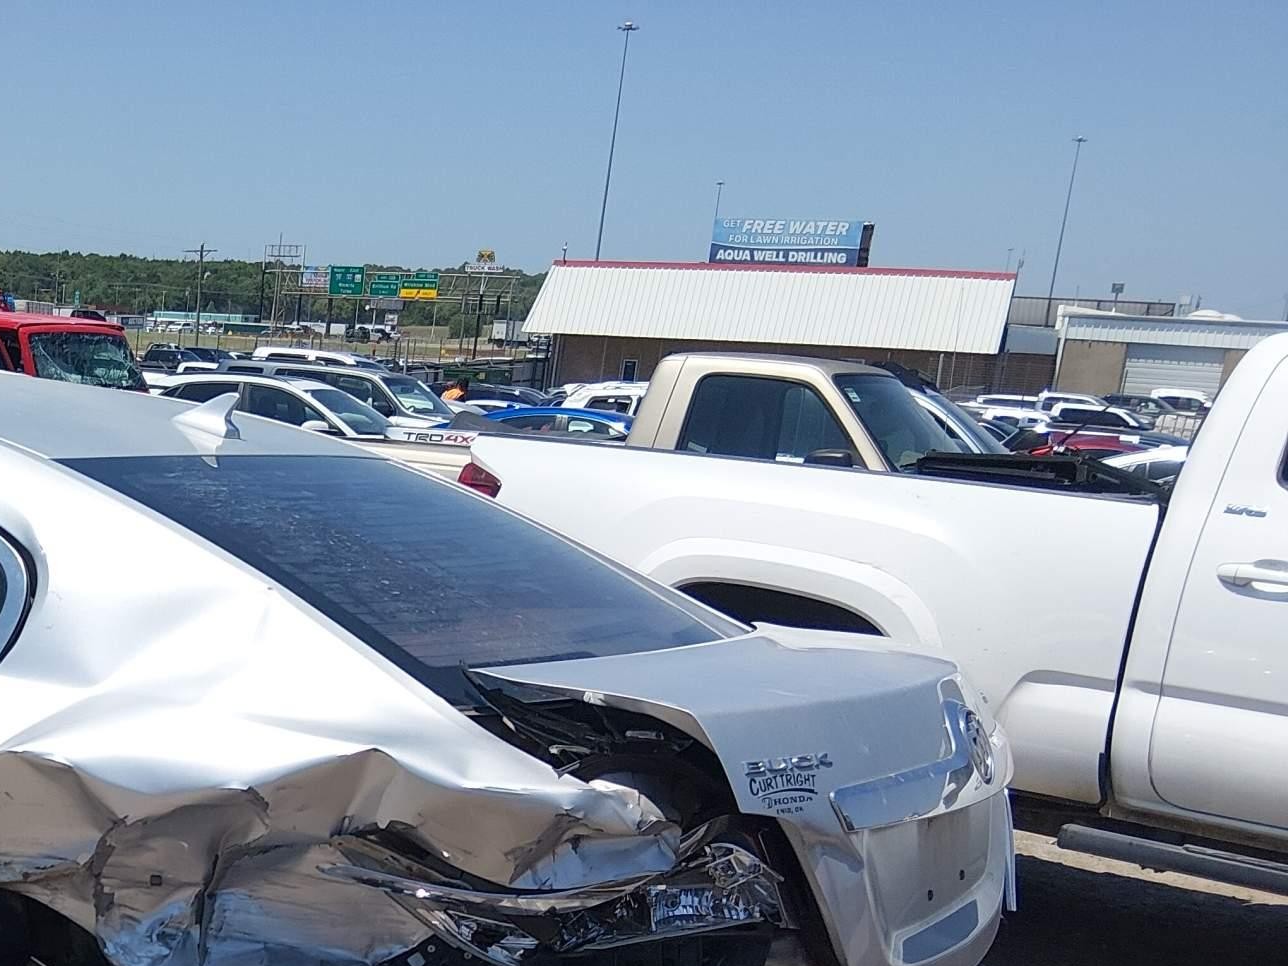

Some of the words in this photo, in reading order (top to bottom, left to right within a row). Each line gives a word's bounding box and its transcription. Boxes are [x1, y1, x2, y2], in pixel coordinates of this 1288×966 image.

[722, 219, 741, 229] GET
[741, 220, 787, 235] FREE
[788, 221, 849, 236] WATER
[728, 234, 748, 244] FOR
[750, 235, 779, 245] LAWN
[780, 236, 838, 246] IRRIGATION
[716, 249, 751, 261] AQUA
[753, 250, 787, 262] WELL
[788, 251, 847, 264] DRILLING
[741, 752, 833, 777] BUICK
[749, 772, 816, 796] CURTTRIGHT
